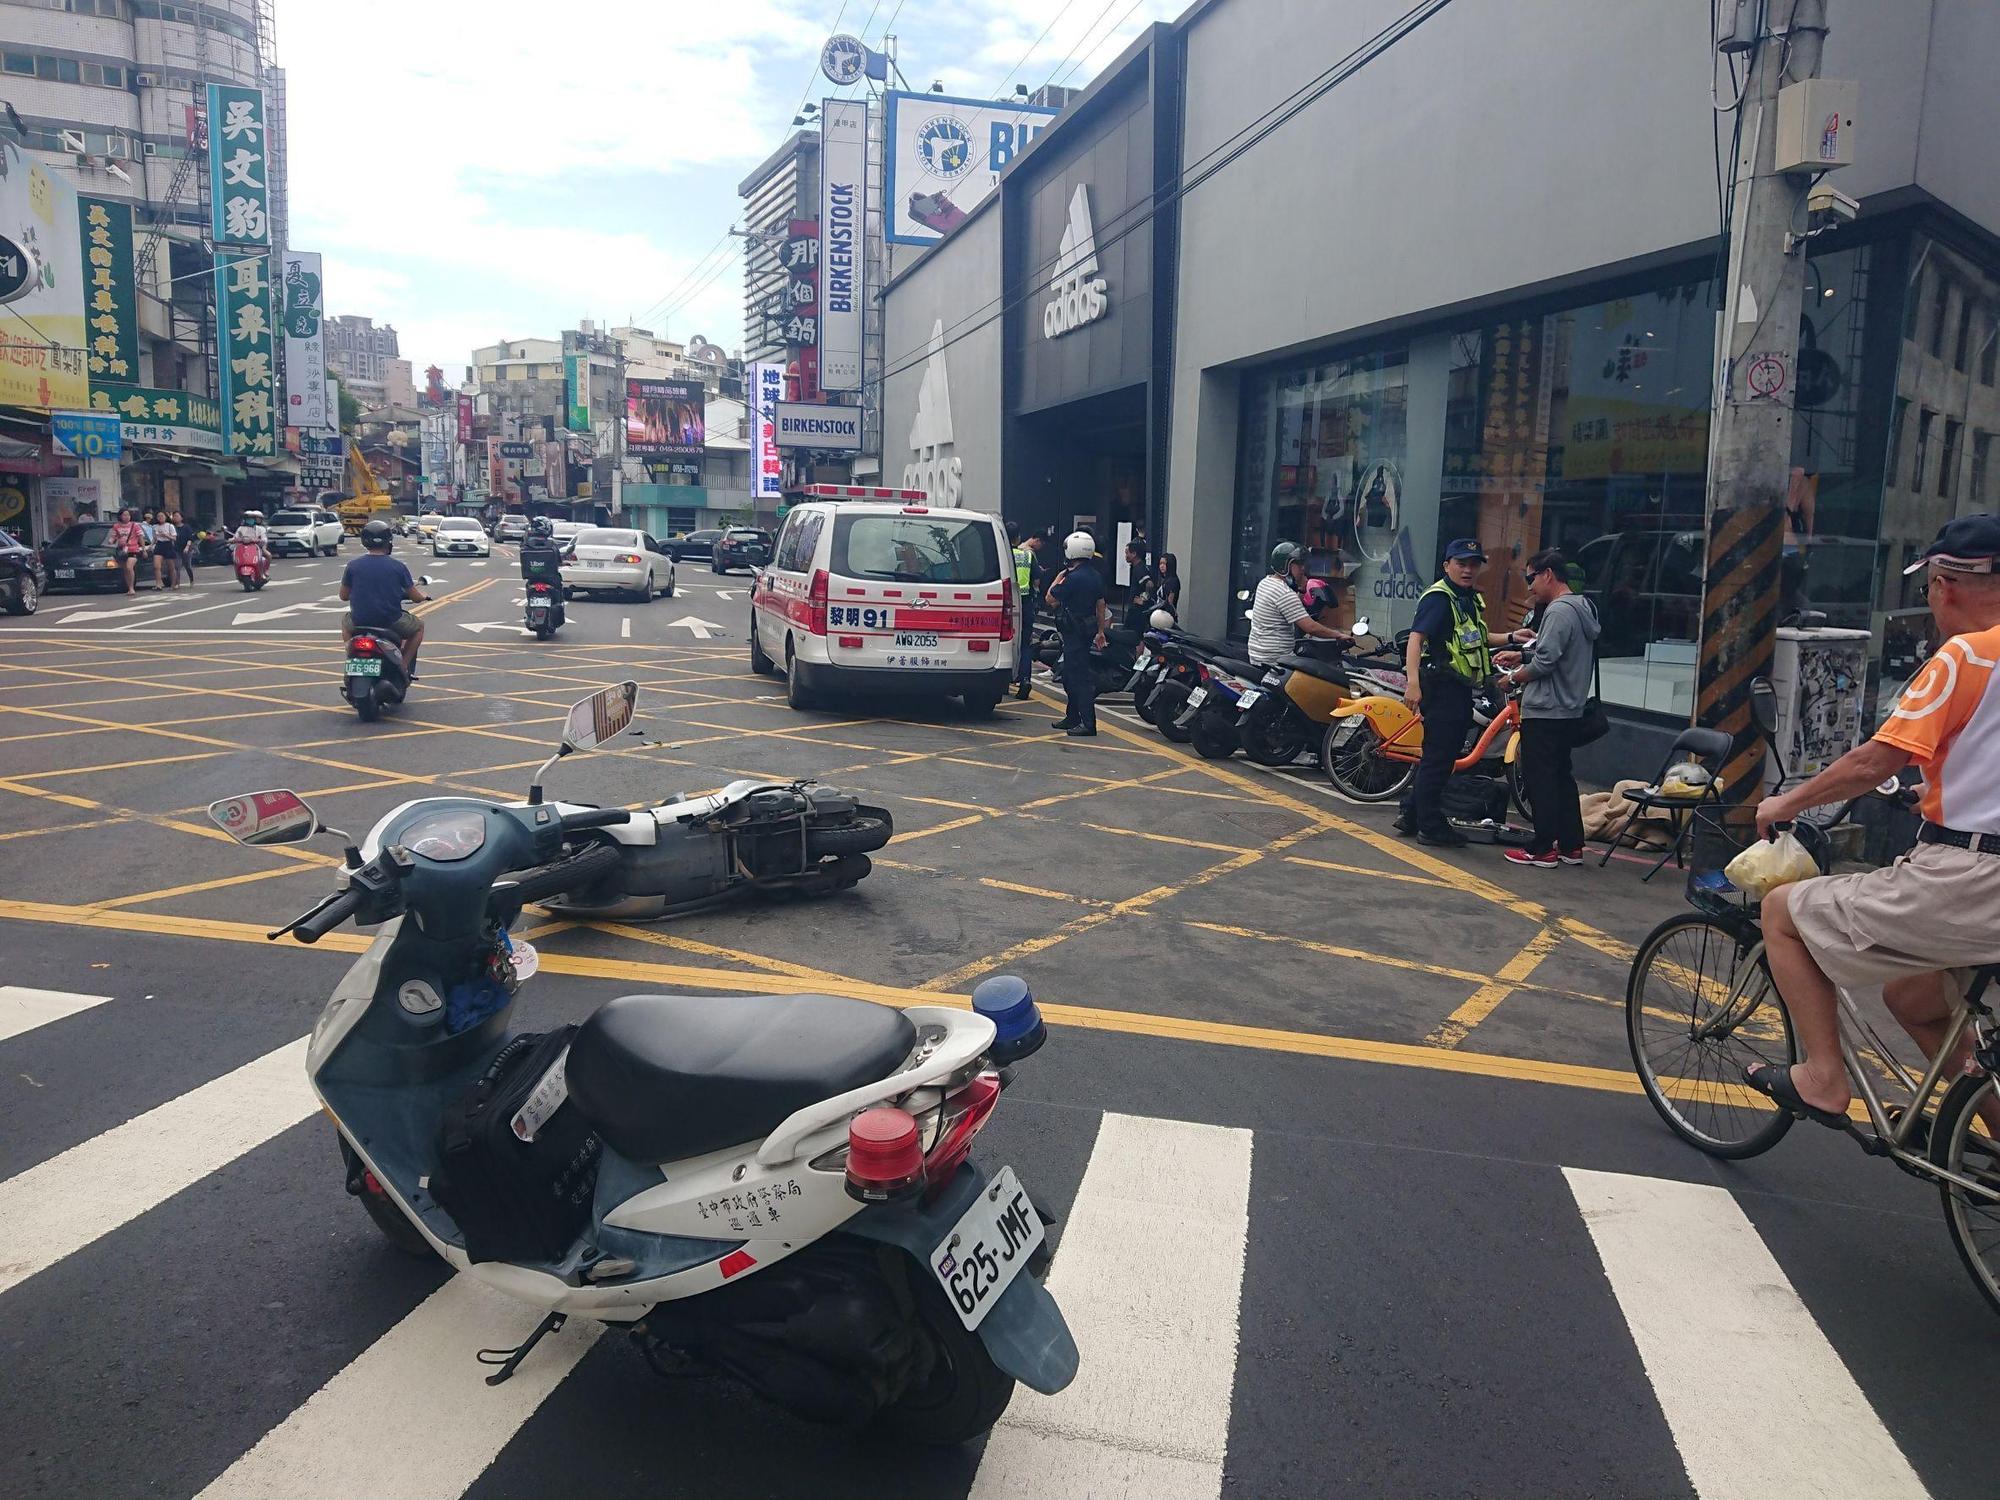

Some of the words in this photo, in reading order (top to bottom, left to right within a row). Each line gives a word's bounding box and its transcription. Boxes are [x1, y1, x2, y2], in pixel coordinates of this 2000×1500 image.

[223, 101, 265, 239] 吳文豹
[990, 121, 1046, 172] BI
[830, 183, 853, 312] BIRKENSTOCK
[786, 239, 818, 345] 那個鍋
[1044, 270, 1108, 339] adidas
[781, 417, 855, 435] BIRKENSTOCK
